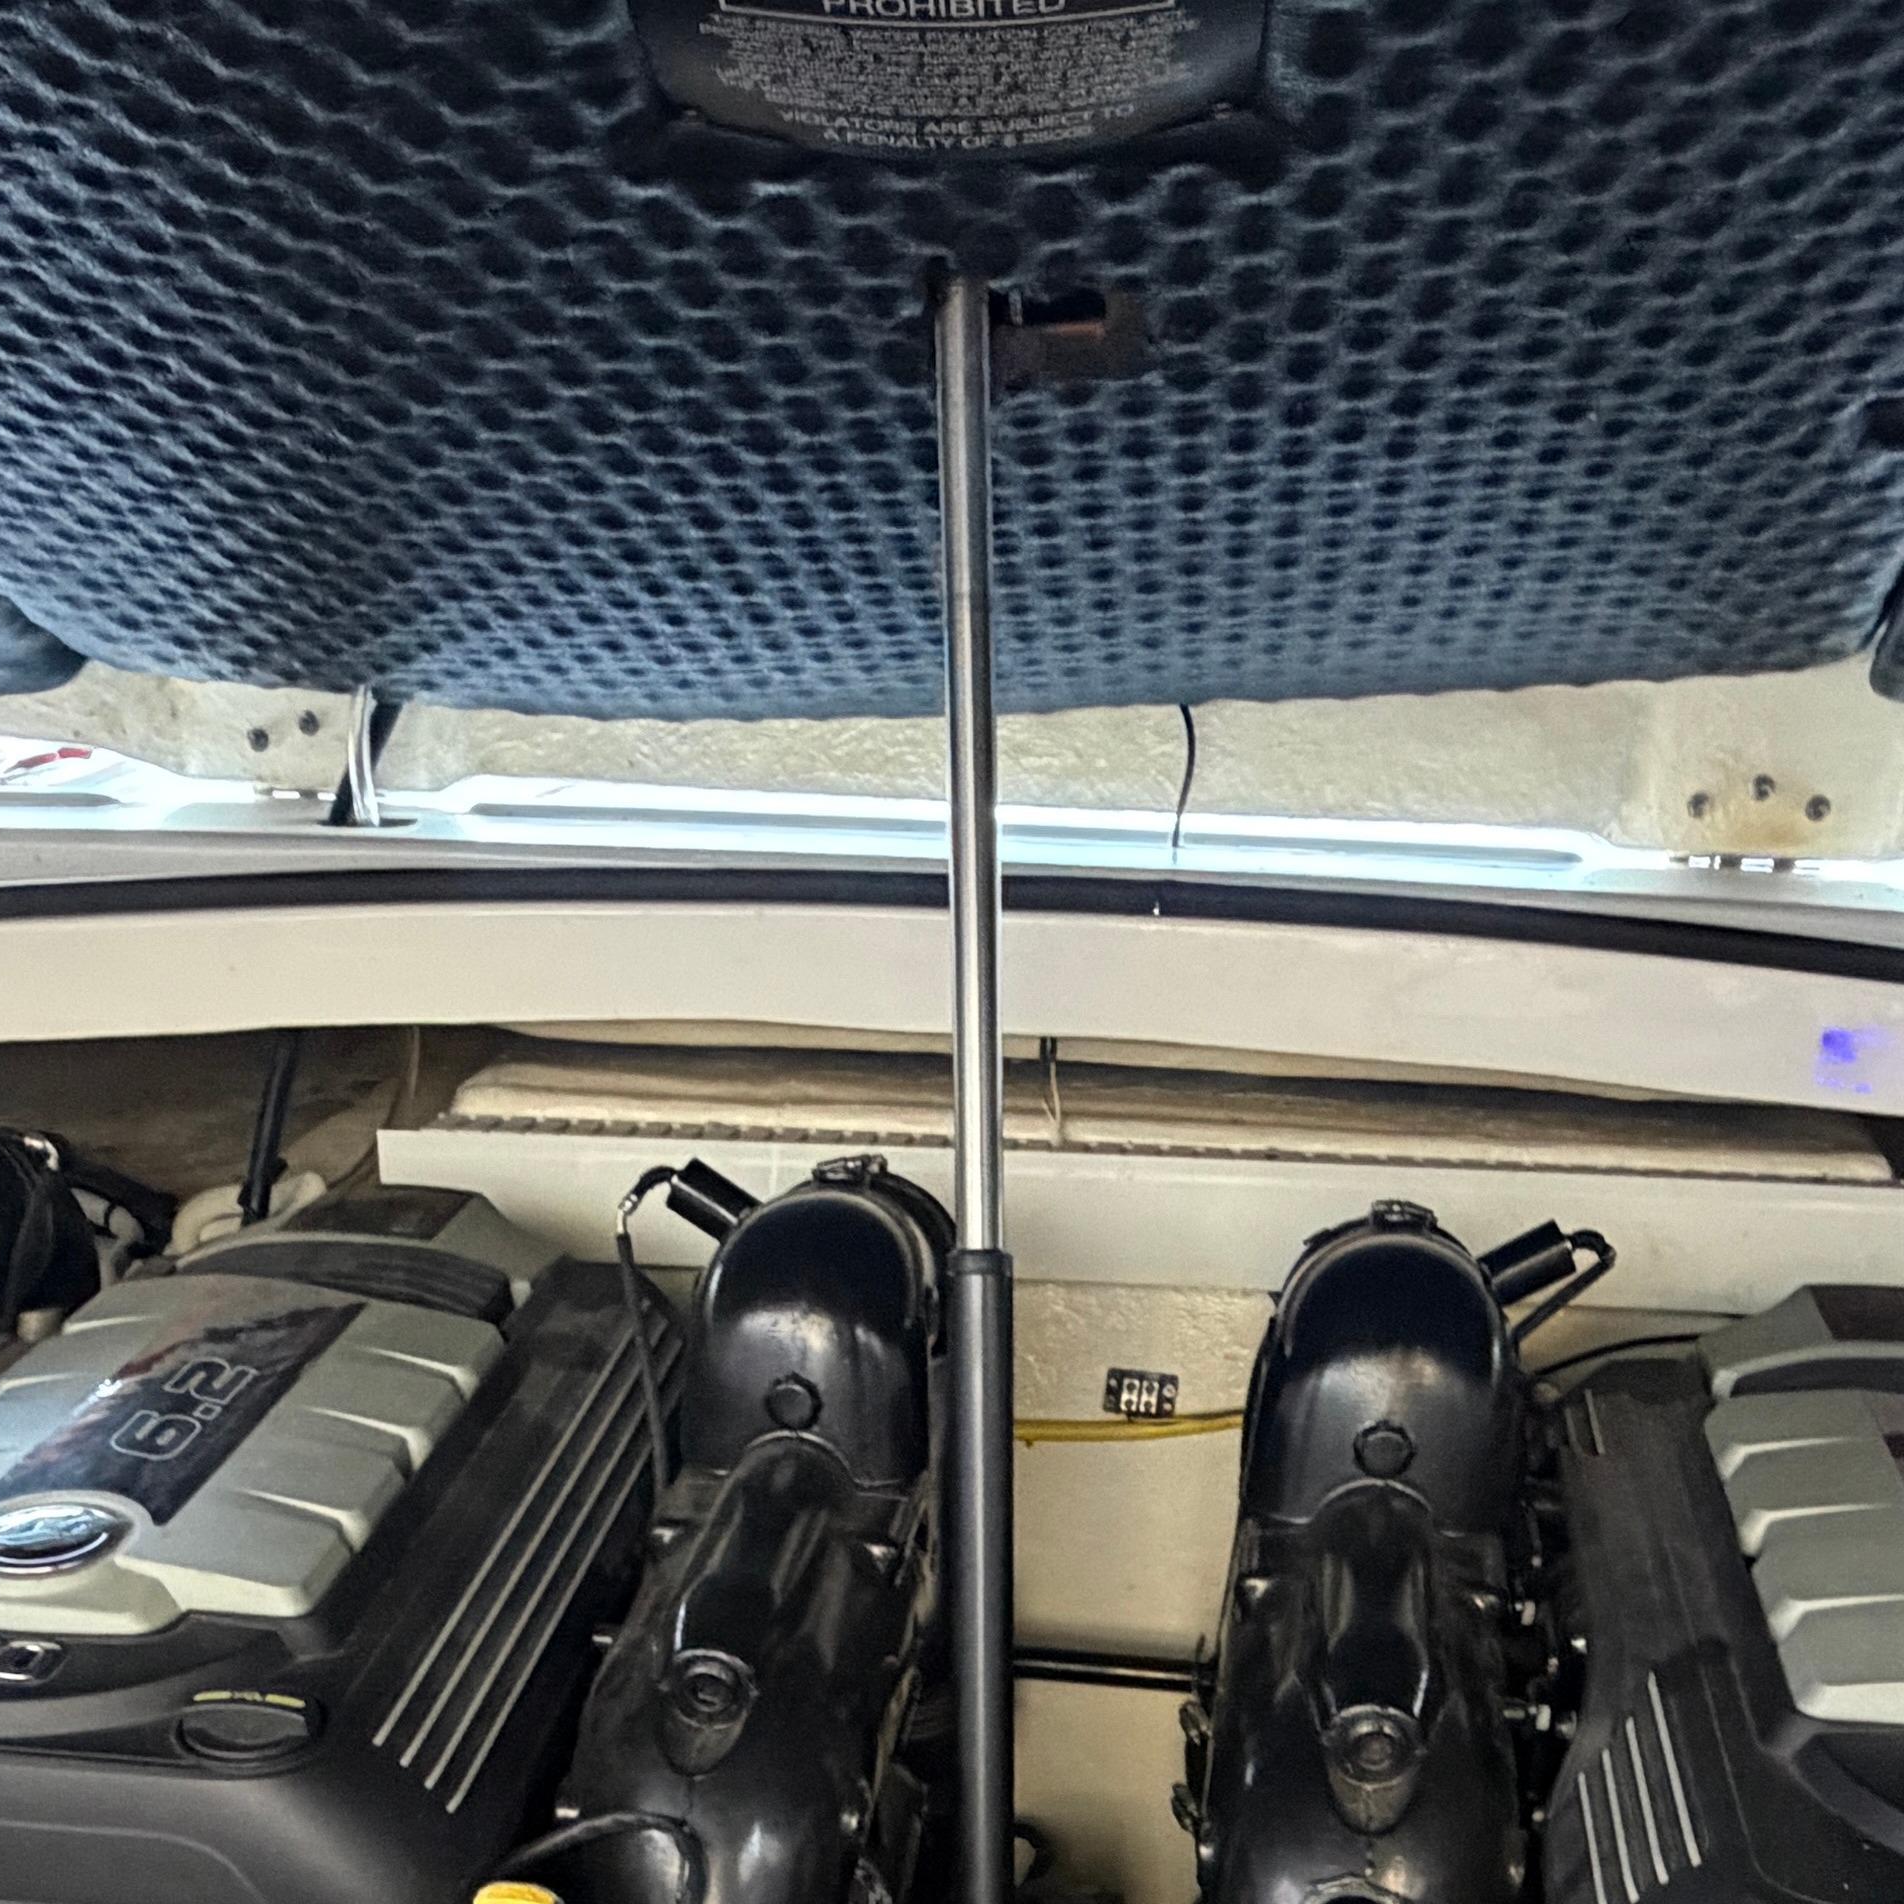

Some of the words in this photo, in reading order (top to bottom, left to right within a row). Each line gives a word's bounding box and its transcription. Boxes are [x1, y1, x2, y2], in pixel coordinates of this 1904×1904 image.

[822, 0, 1065, 18] PROHIBITED
[780, 110, 917, 134] VIOLATORS
[924, 120, 972, 135] ARE
[981, 110, 1094, 133] SUBJECT
[1102, 103, 1135, 119] TO
[823, 127, 840, 141] A
[847, 130, 956, 149] PENALTY
[960, 134, 994, 149] OF
[110, 1355, 259, 1462] 6.2
